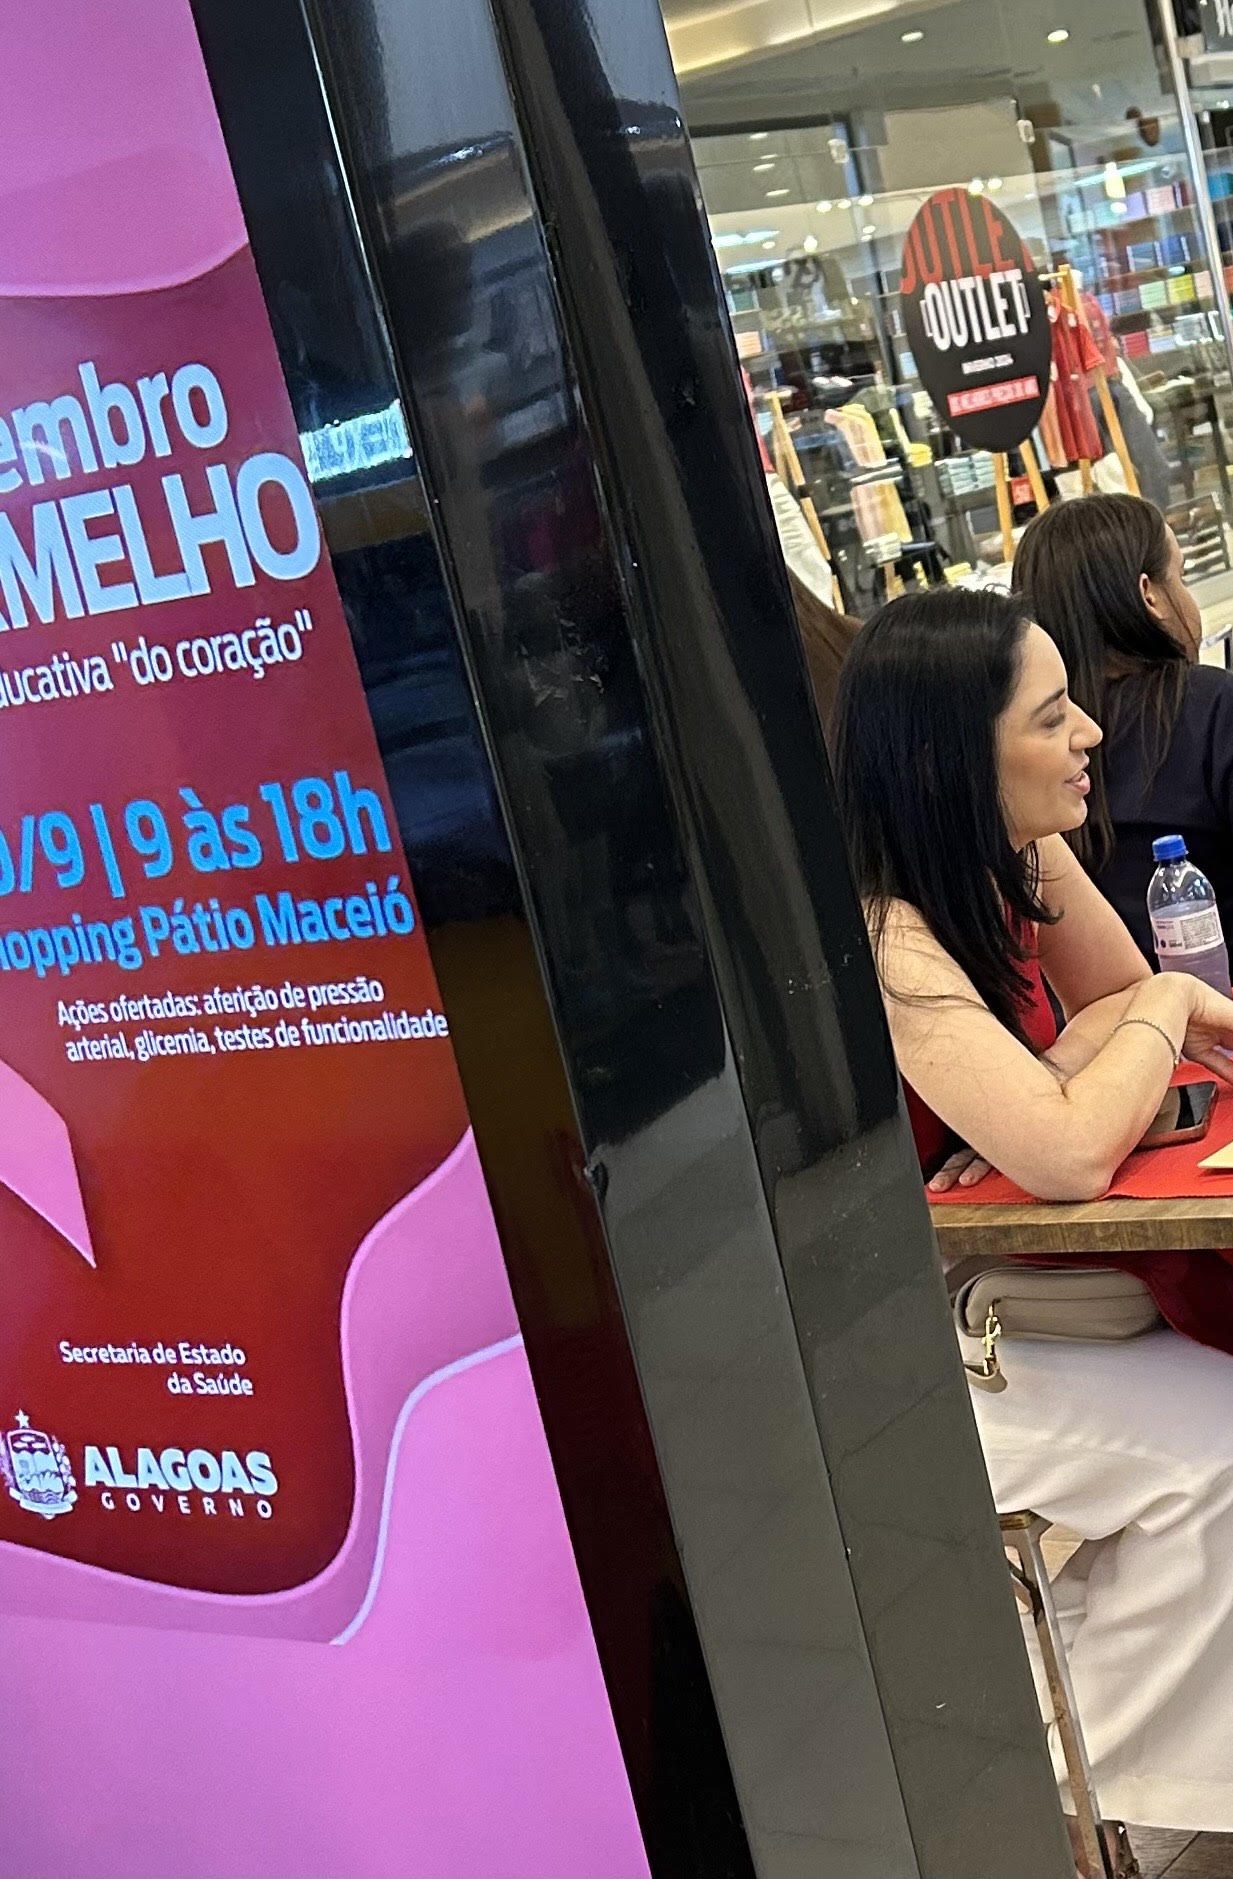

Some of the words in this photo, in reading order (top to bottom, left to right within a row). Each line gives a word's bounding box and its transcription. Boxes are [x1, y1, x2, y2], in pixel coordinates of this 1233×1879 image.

[924, 269, 1028, 350] OUTLET
[0, 452, 321, 632] MELHO
[0, 651, 114, 707] ucativa
[177, 609, 313, 679] coração"
[124, 799, 174, 878] 9
[179, 787, 263, 873] às
[260, 771, 392, 863] 18h
[139, 898, 255, 957] Pátio
[255, 876, 415, 947] Maceió
[57, 1000, 109, 1031] Ações
[109, 990, 202, 1023] ofertadas:
[203, 984, 279, 1018] aferição
[280, 981, 307, 1009] de
[307, 976, 385, 1012] pressão
[65, 1031, 136, 1062] arterial,
[134, 1027, 217, 1062] glicemia,
[214, 1022, 275, 1052] testes
[274, 1019, 301, 1048] de
[301, 1008, 450, 1046] funcionalidade
[59, 1341, 152, 1364] Secretaria
[152, 1342, 177, 1364] de
[177, 1342, 246, 1366] Estado
[167, 1371, 194, 1395] da
[194, 1371, 254, 1396] Saúde
[84, 1445, 279, 1496] ALAGOAS
[101, 1492, 273, 1519] GOVERNO
